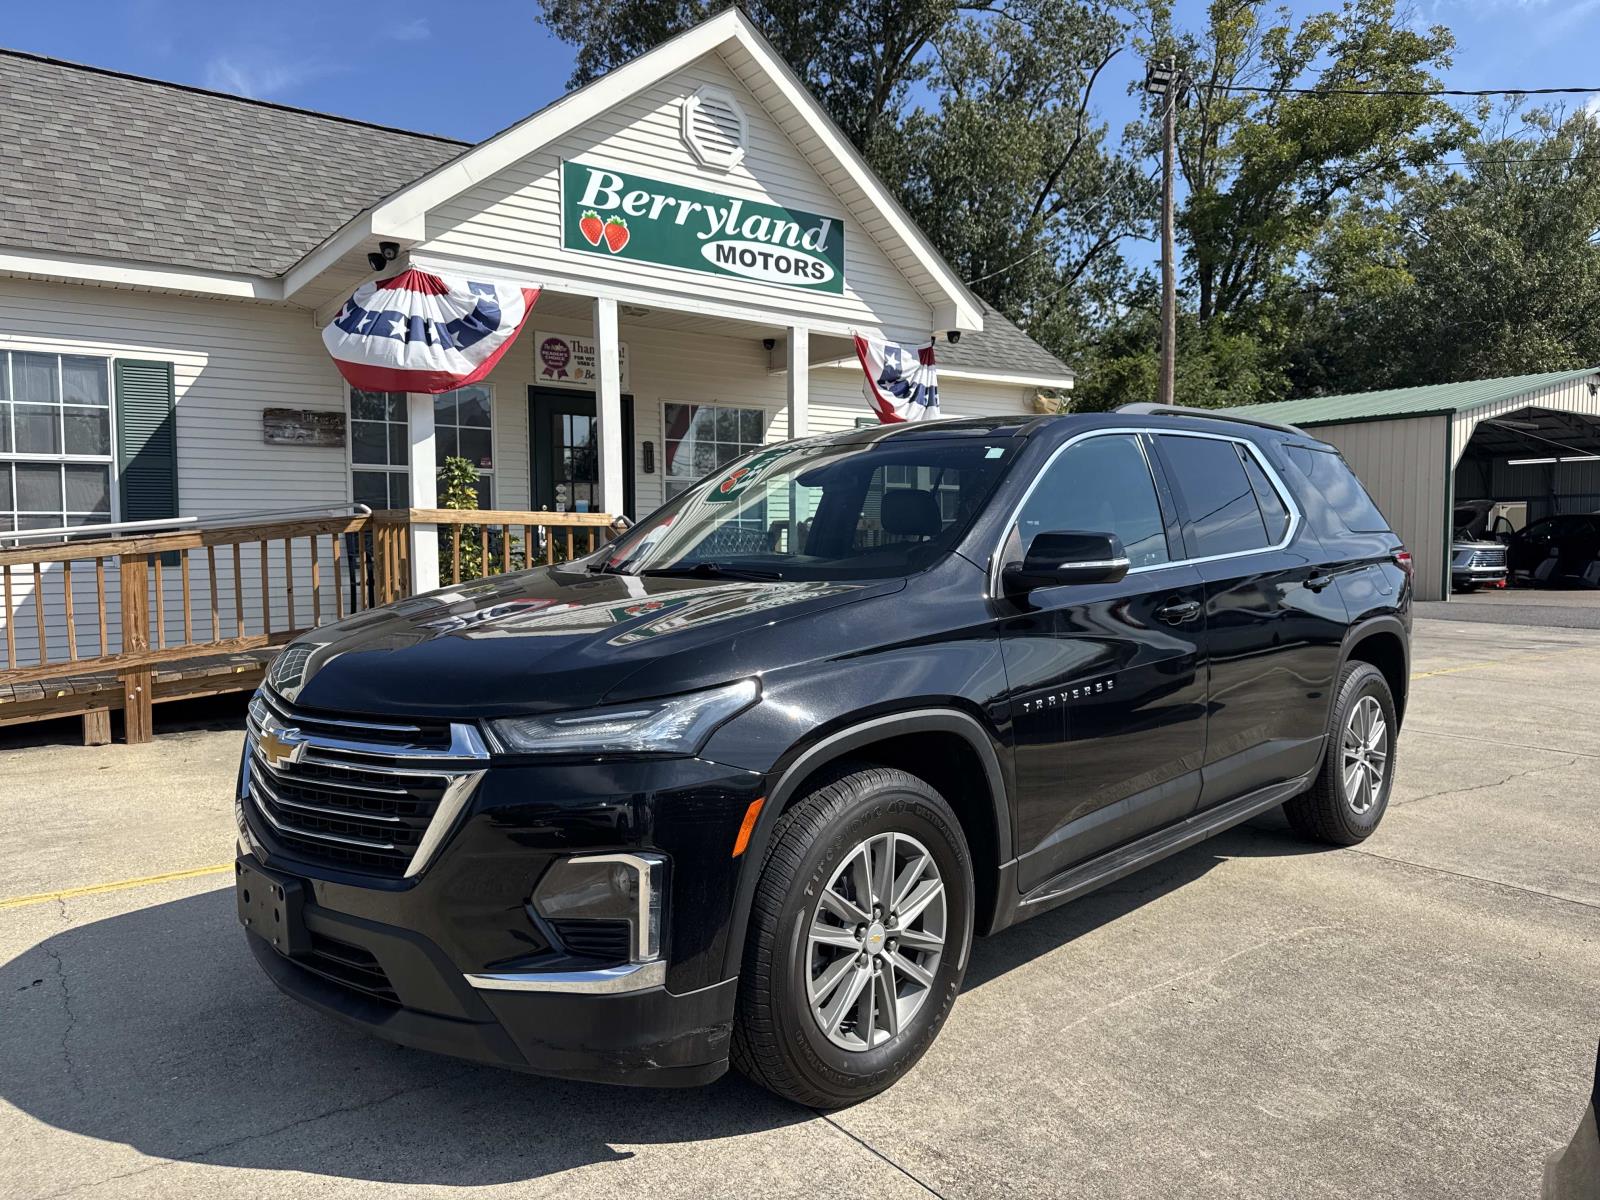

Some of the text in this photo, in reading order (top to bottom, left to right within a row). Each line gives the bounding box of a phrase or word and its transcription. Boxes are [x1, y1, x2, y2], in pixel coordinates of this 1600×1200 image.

[577, 168, 832, 253] Berryland
[715, 243, 826, 280] MOTORS
[570, 340, 595, 354] Than
[1023, 680, 1114, 712] TRAVERSE
